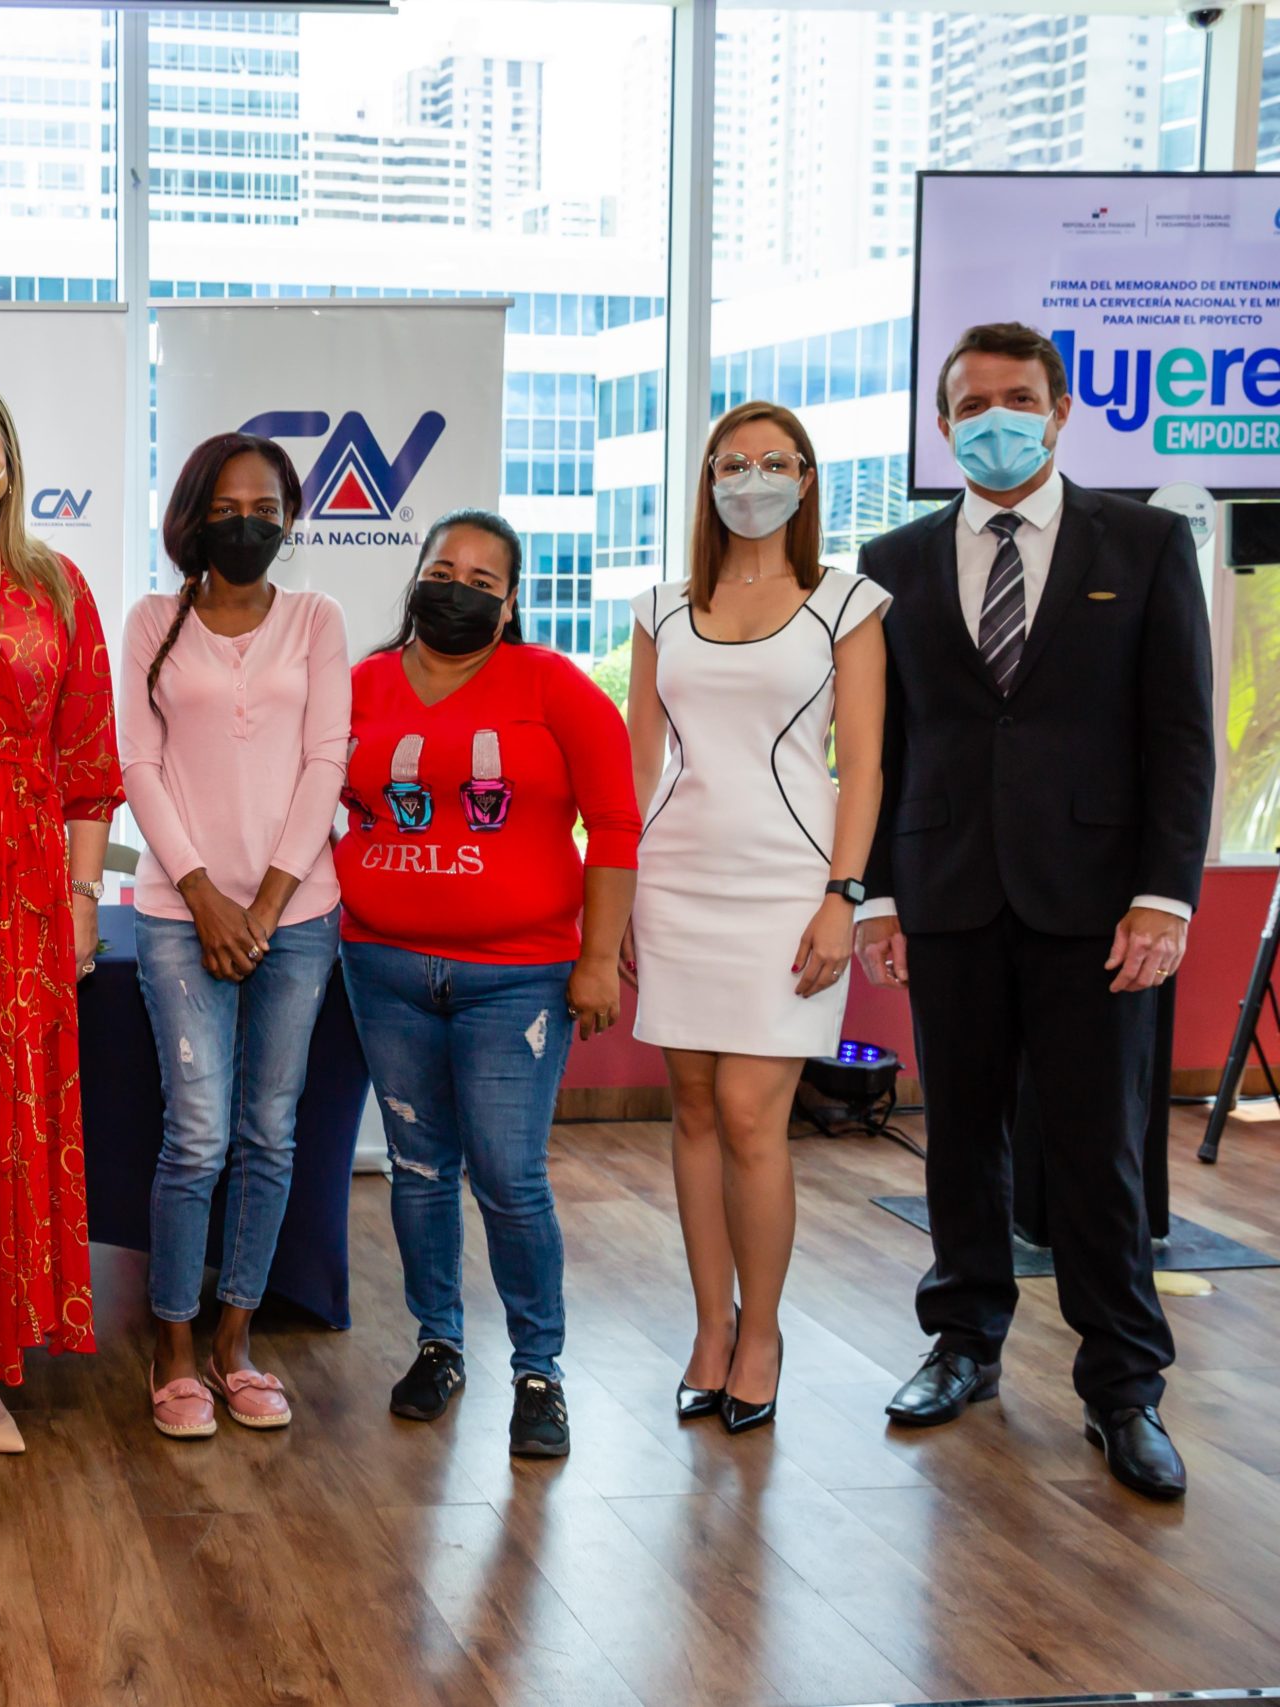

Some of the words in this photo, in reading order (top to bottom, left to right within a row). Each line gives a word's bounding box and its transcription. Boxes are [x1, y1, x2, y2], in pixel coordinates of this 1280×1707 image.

[1050, 280, 1087, 290] FIRMA
[1090, 280, 1112, 290] DEL
[1115, 280, 1197, 291] MEMORANDO
[1201, 280, 1217, 290] DE
[1042, 297, 1079, 308] ENTRE
[1083, 297, 1097, 308] LA
[1100, 295, 1171, 308] CERVECERÍA
[1174, 297, 1236, 308] NACIONAL
[1239, 297, 1247, 307] Y
[1250, 297, 1262, 308] EL
[1102, 315, 1133, 325] PARA
[1137, 315, 1180, 325] INICIAR
[1184, 315, 1197, 325] EL
[1200, 315, 1263, 325] PROYECTO
[329, 532, 422, 545] NACIONAL
[361, 843, 484, 874] GIRLS
